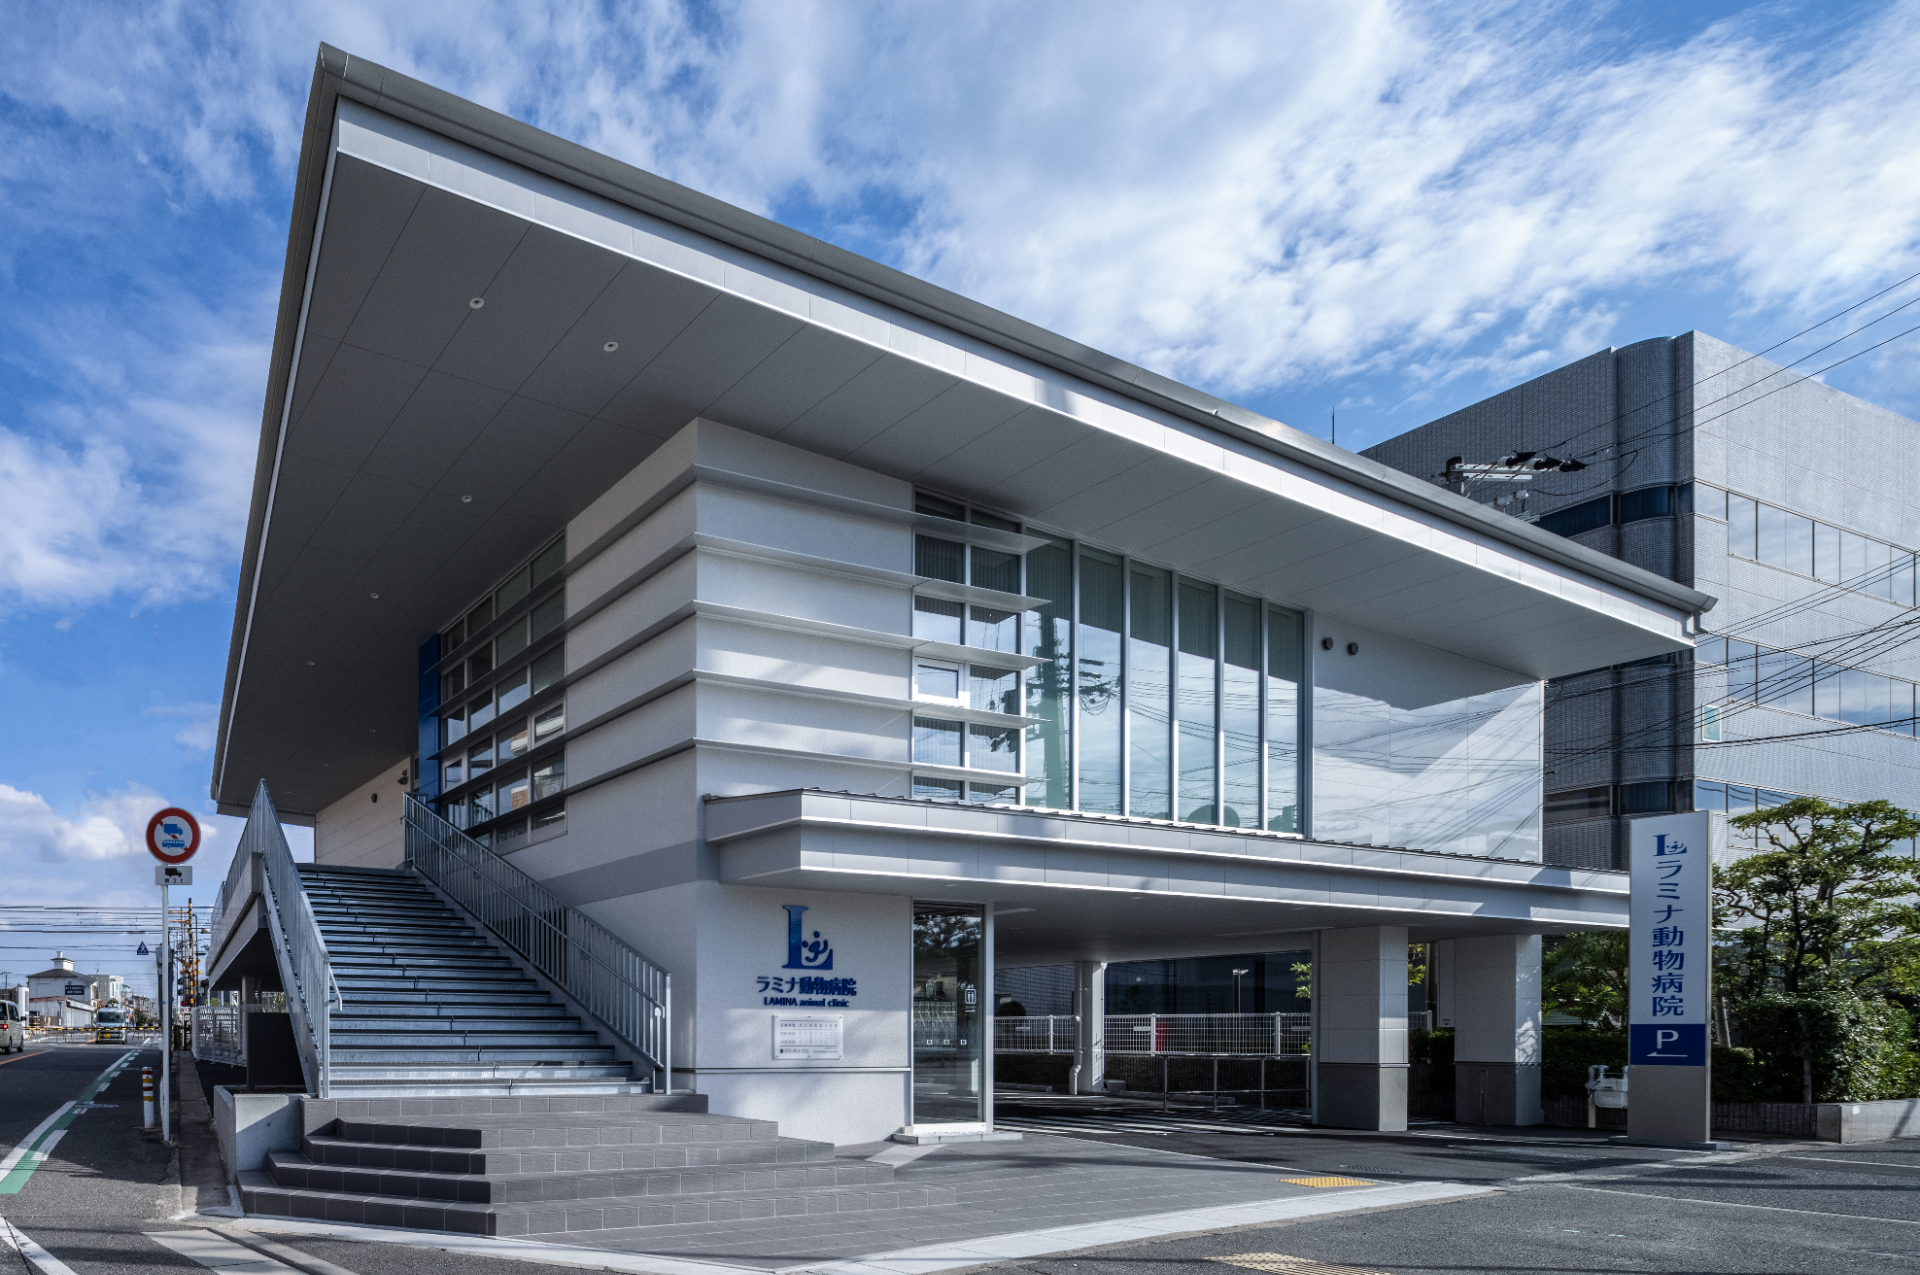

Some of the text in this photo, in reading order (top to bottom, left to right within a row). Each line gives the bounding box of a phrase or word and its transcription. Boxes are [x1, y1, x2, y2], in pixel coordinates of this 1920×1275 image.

[1651, 860, 1685, 1017] ラミナ動物病院
[756, 976, 857, 996] ラミナ動物病院
[764, 997, 850, 1008] LAMINA animal clinic
[1656, 1029, 1679, 1050] P
